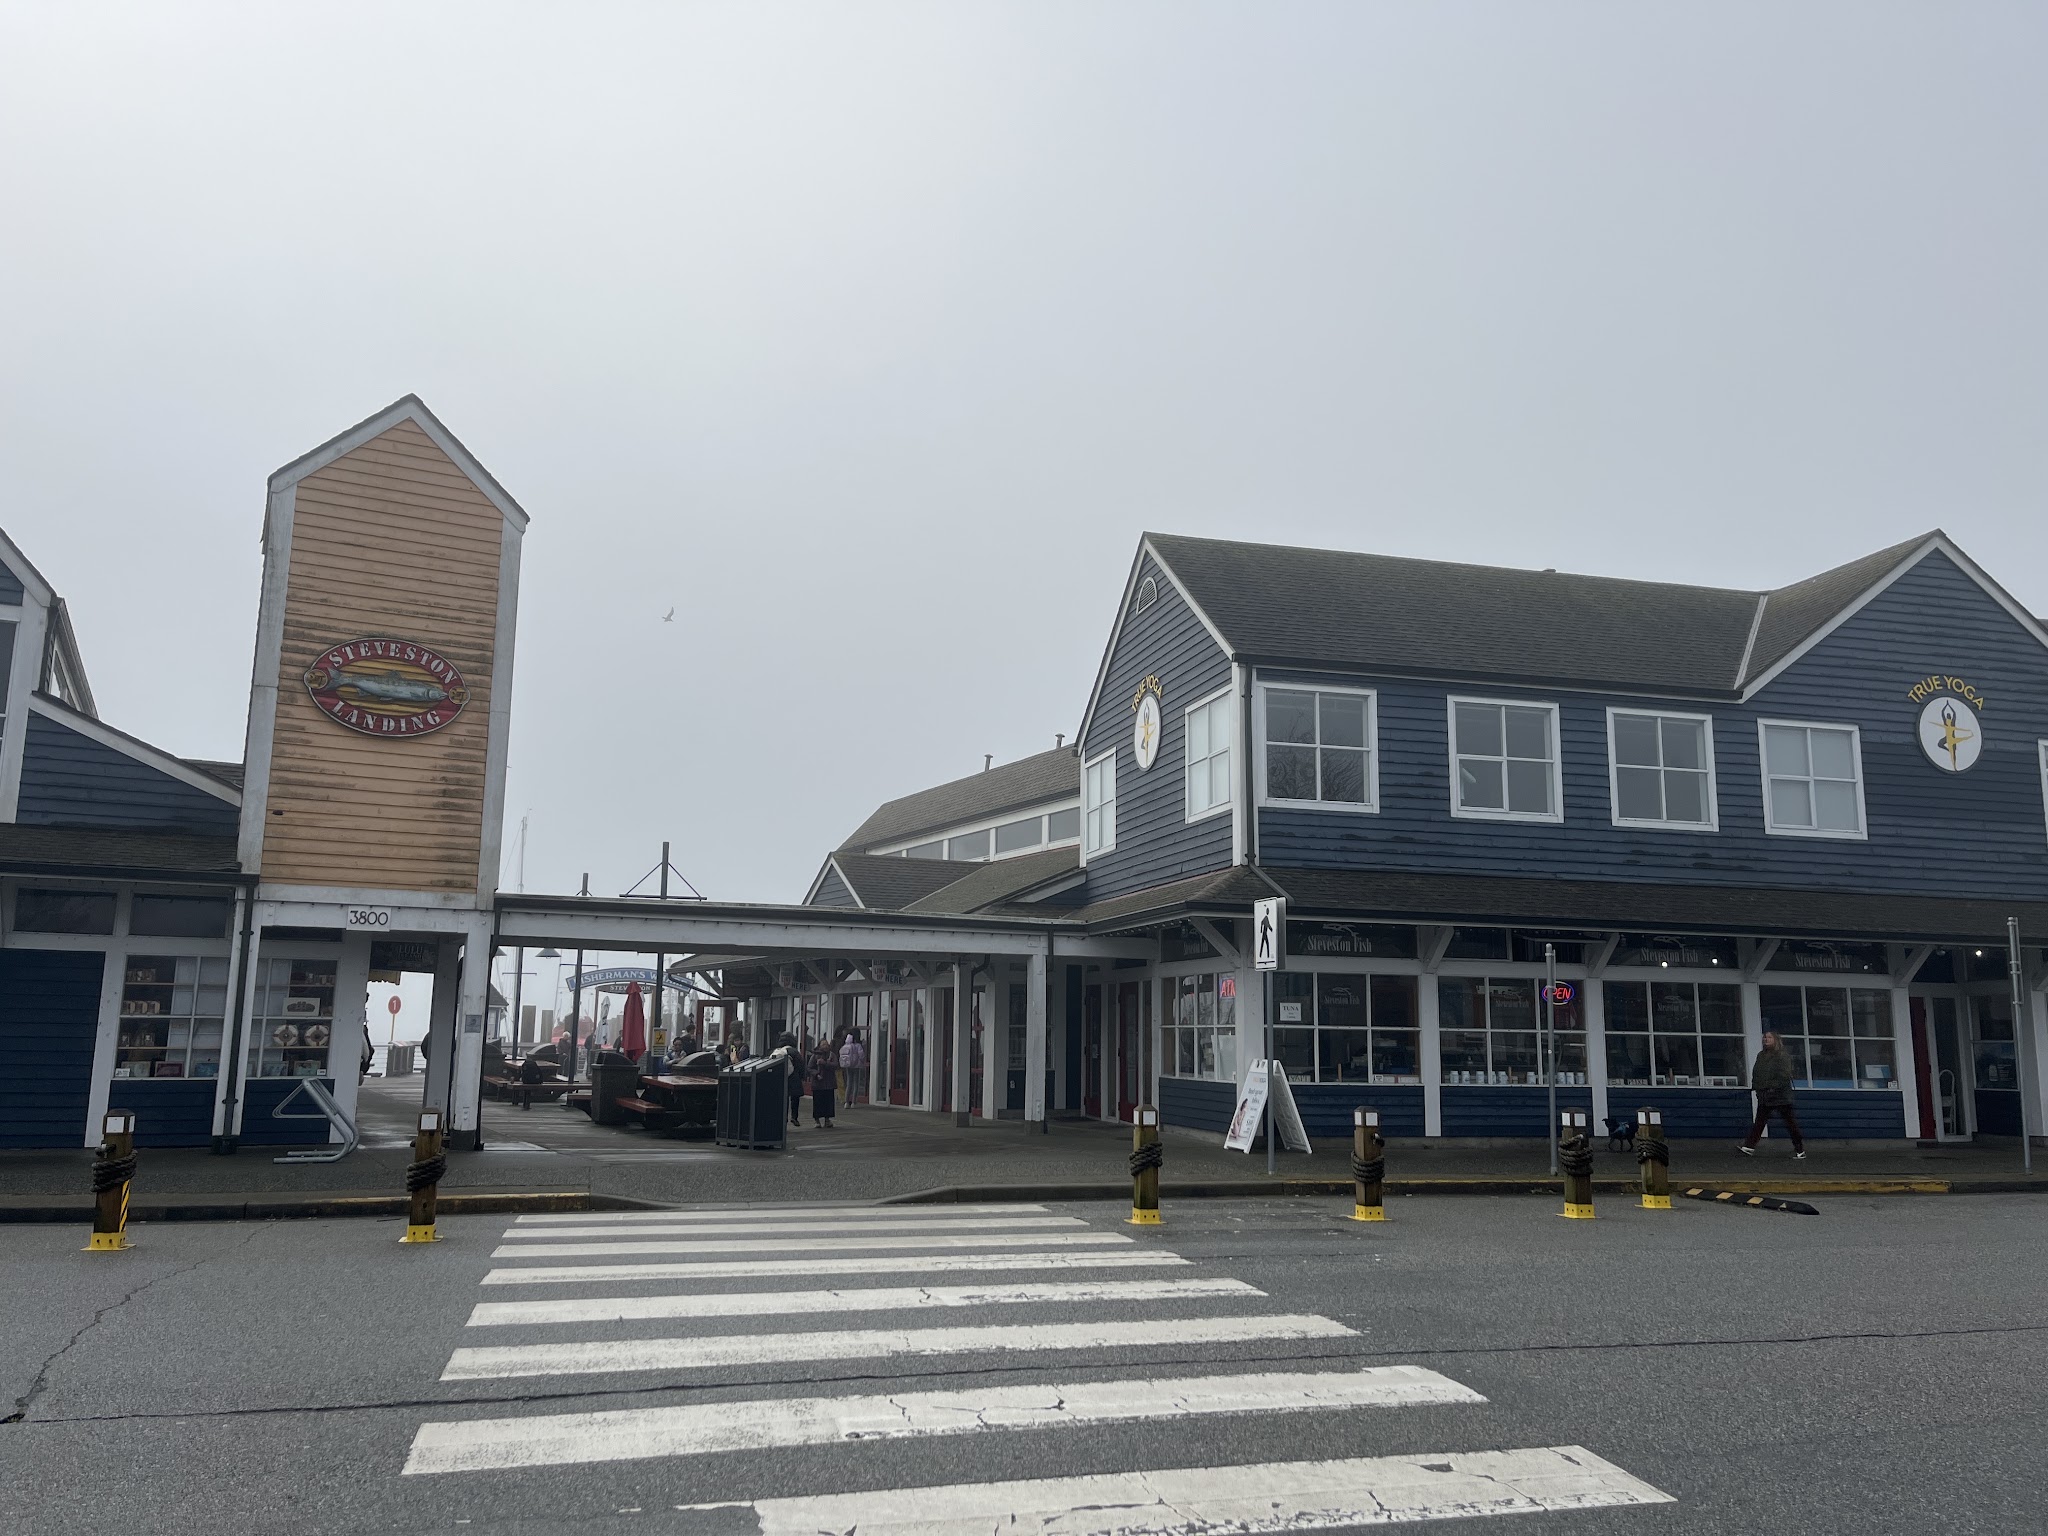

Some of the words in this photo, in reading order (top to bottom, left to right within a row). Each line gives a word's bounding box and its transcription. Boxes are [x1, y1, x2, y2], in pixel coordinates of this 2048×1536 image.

[329, 641, 457, 684] STEVESTON
[1132, 679, 1147, 712] TRUE
[1146, 675, 1163, 699] YOGA
[1908, 675, 1943, 703] TRUE
[1943, 675, 1984, 710] YOGA
[331, 700, 441, 732] LANDING
[350, 910, 388, 925] 3800
[1307, 935, 1351, 951] Steveston
[1353, 936, 1372, 952] Fish
[1641, 948, 1680, 963] Steveston
[1682, 948, 1698, 963] Fish
[1795, 953, 1832, 968] Steveston
[1834, 954, 1850, 968] Fish
[575, 971, 646, 986] ISHERMAN'S
[885, 974, 902, 984] HERE
[791, 982, 807, 991] HERE
[392, 1000, 397, 1010] 1
